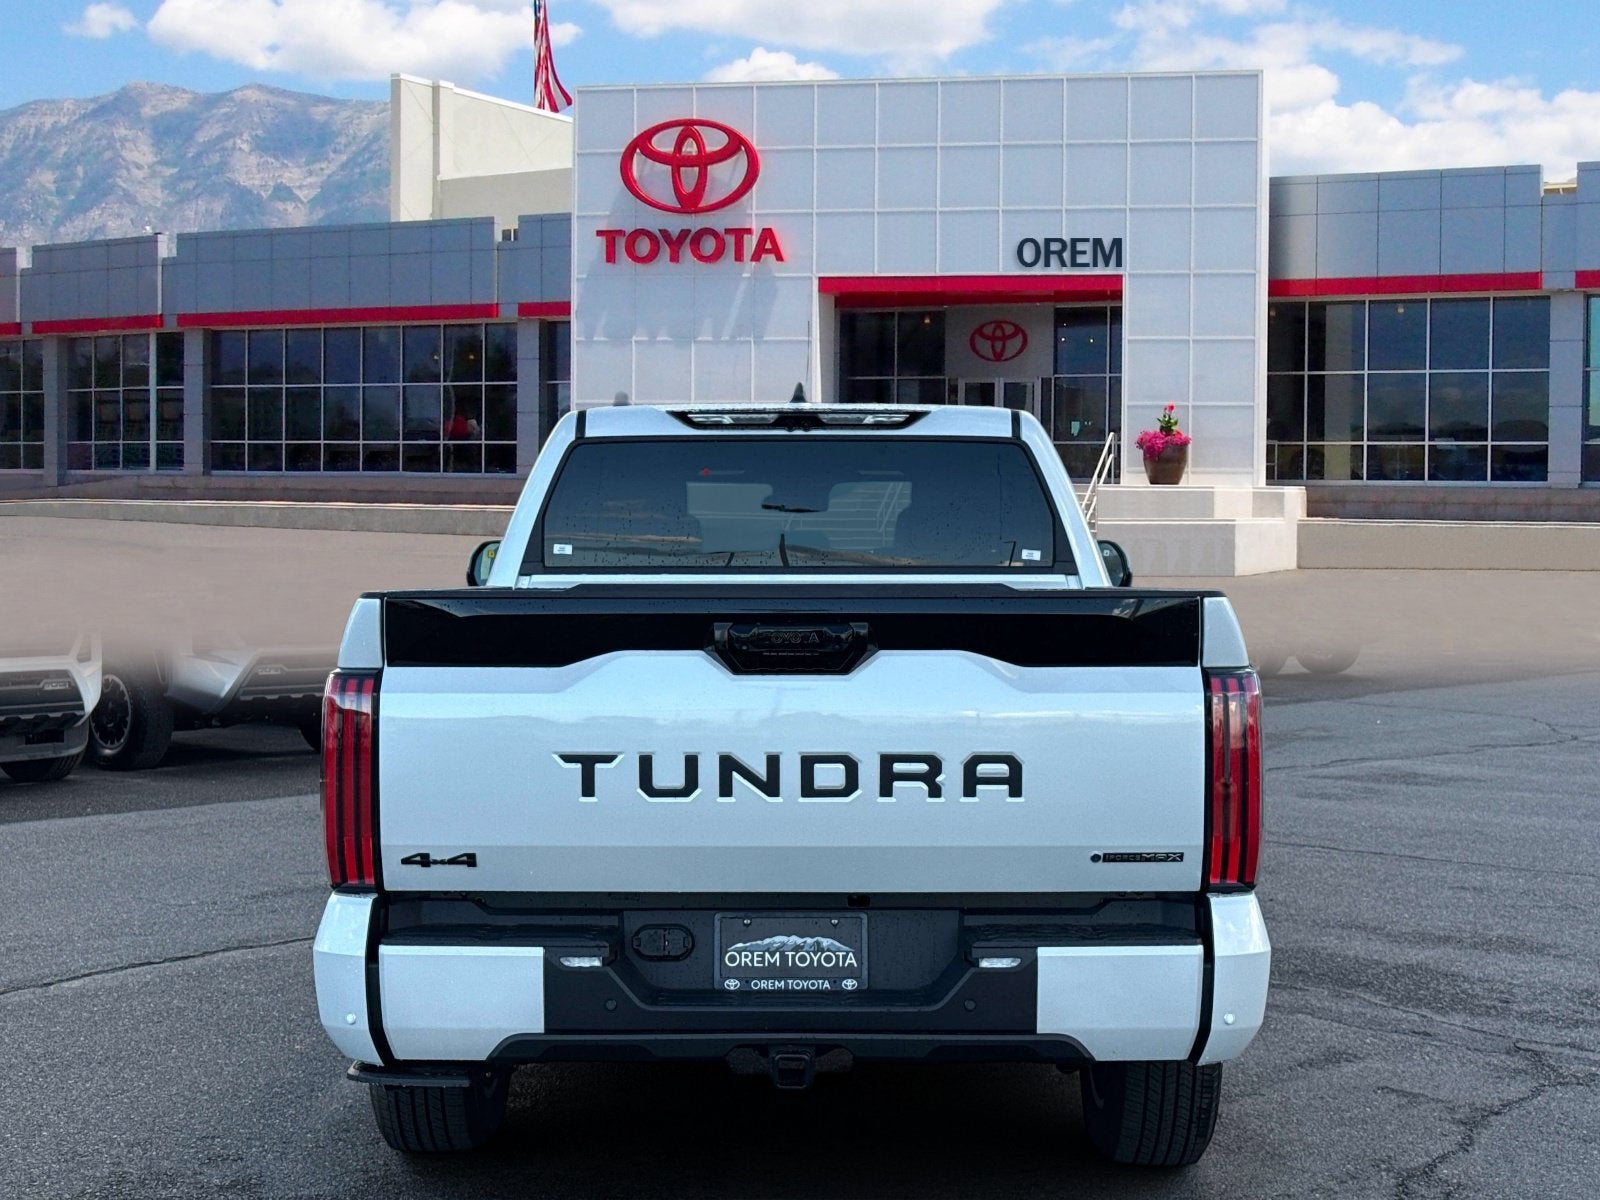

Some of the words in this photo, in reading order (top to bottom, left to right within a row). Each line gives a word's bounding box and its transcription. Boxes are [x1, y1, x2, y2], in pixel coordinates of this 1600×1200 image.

[596, 227, 785, 264] TOYOTA
[1016, 237, 1123, 268] OREM
[762, 631, 820, 643] OYOA
[553, 752, 1024, 802] TUNDRA
[725, 951, 779, 967] OREM
[785, 951, 857, 967] TOYOTA
[751, 979, 784, 990] OREM
[787, 979, 831, 990] TOYOTA
